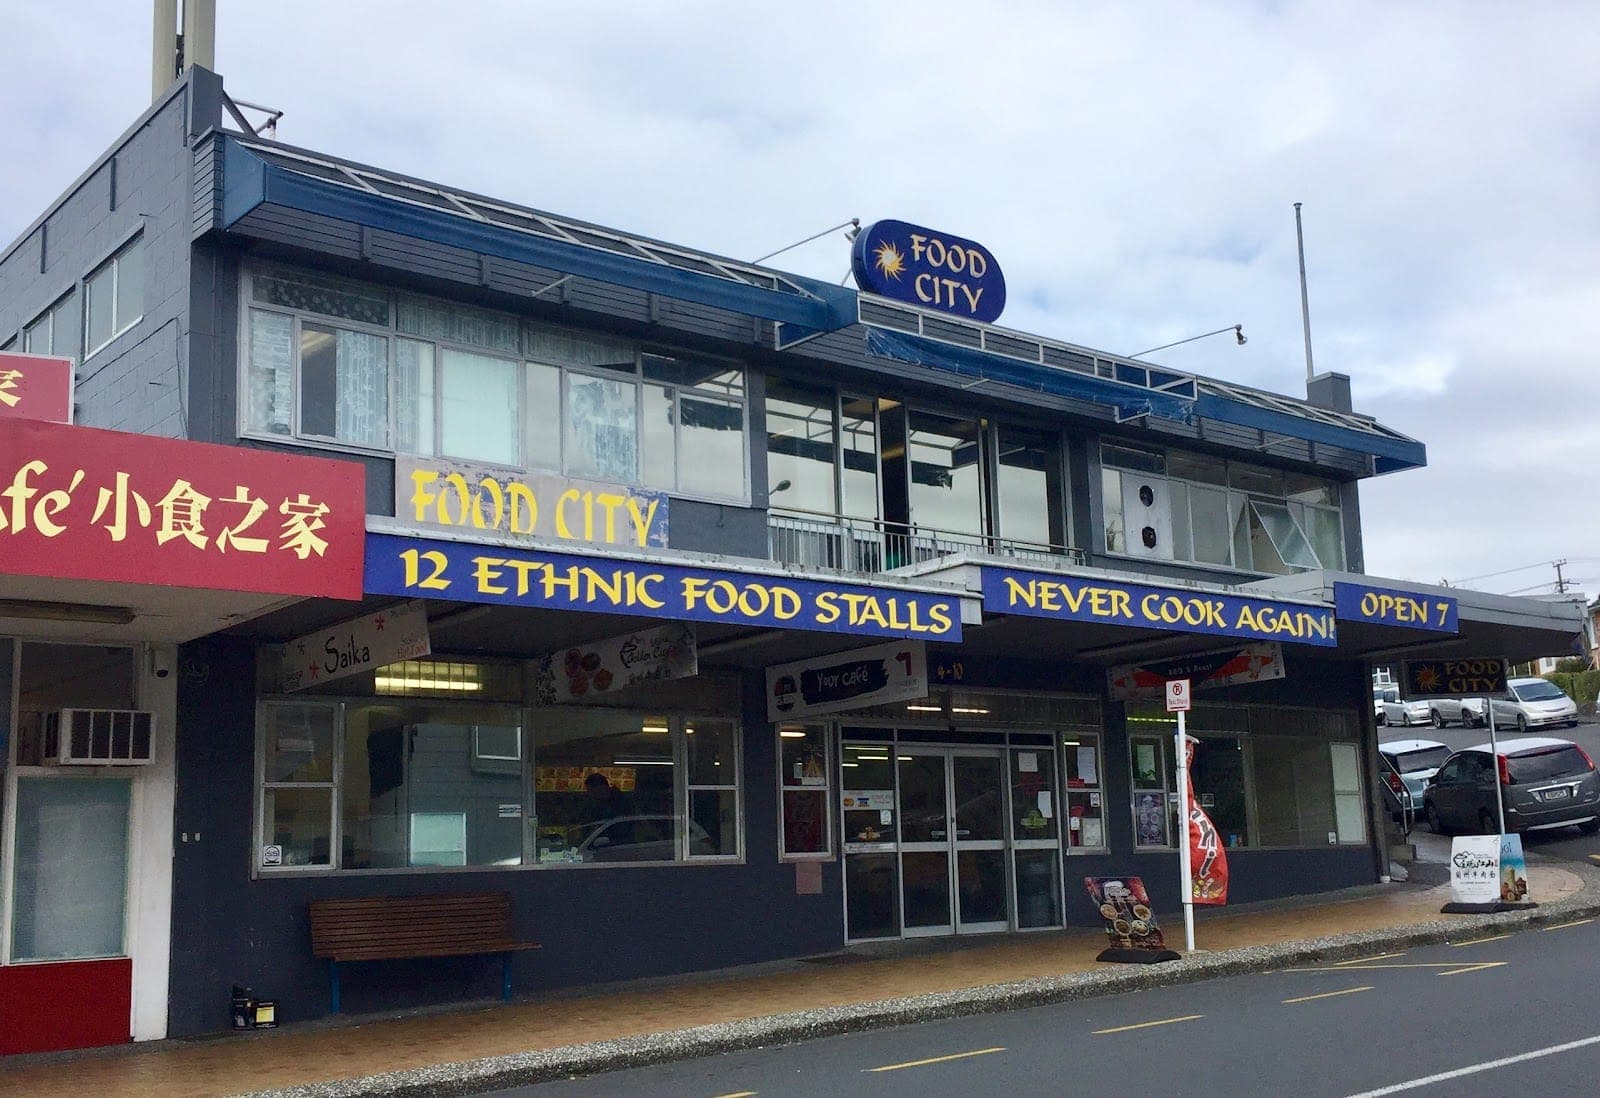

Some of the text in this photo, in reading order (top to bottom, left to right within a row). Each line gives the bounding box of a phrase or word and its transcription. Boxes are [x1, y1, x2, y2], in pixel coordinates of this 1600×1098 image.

[909, 234, 987, 278] FOOD
[915, 273, 984, 313] CITY
[90, 471, 331, 560] 小食之家
[410, 469, 659, 548] FOOD CITY
[400, 549, 953, 635] 12 ETHNIC FOOD STALLS
[1003, 576, 1336, 639] NEVER COOK AGAIN!
[1360, 592, 1450, 627] OPEN 7
[324, 635, 371, 674] Saika
[1445, 660, 1500, 676] FOOD
[1449, 678, 1497, 692] CITY
